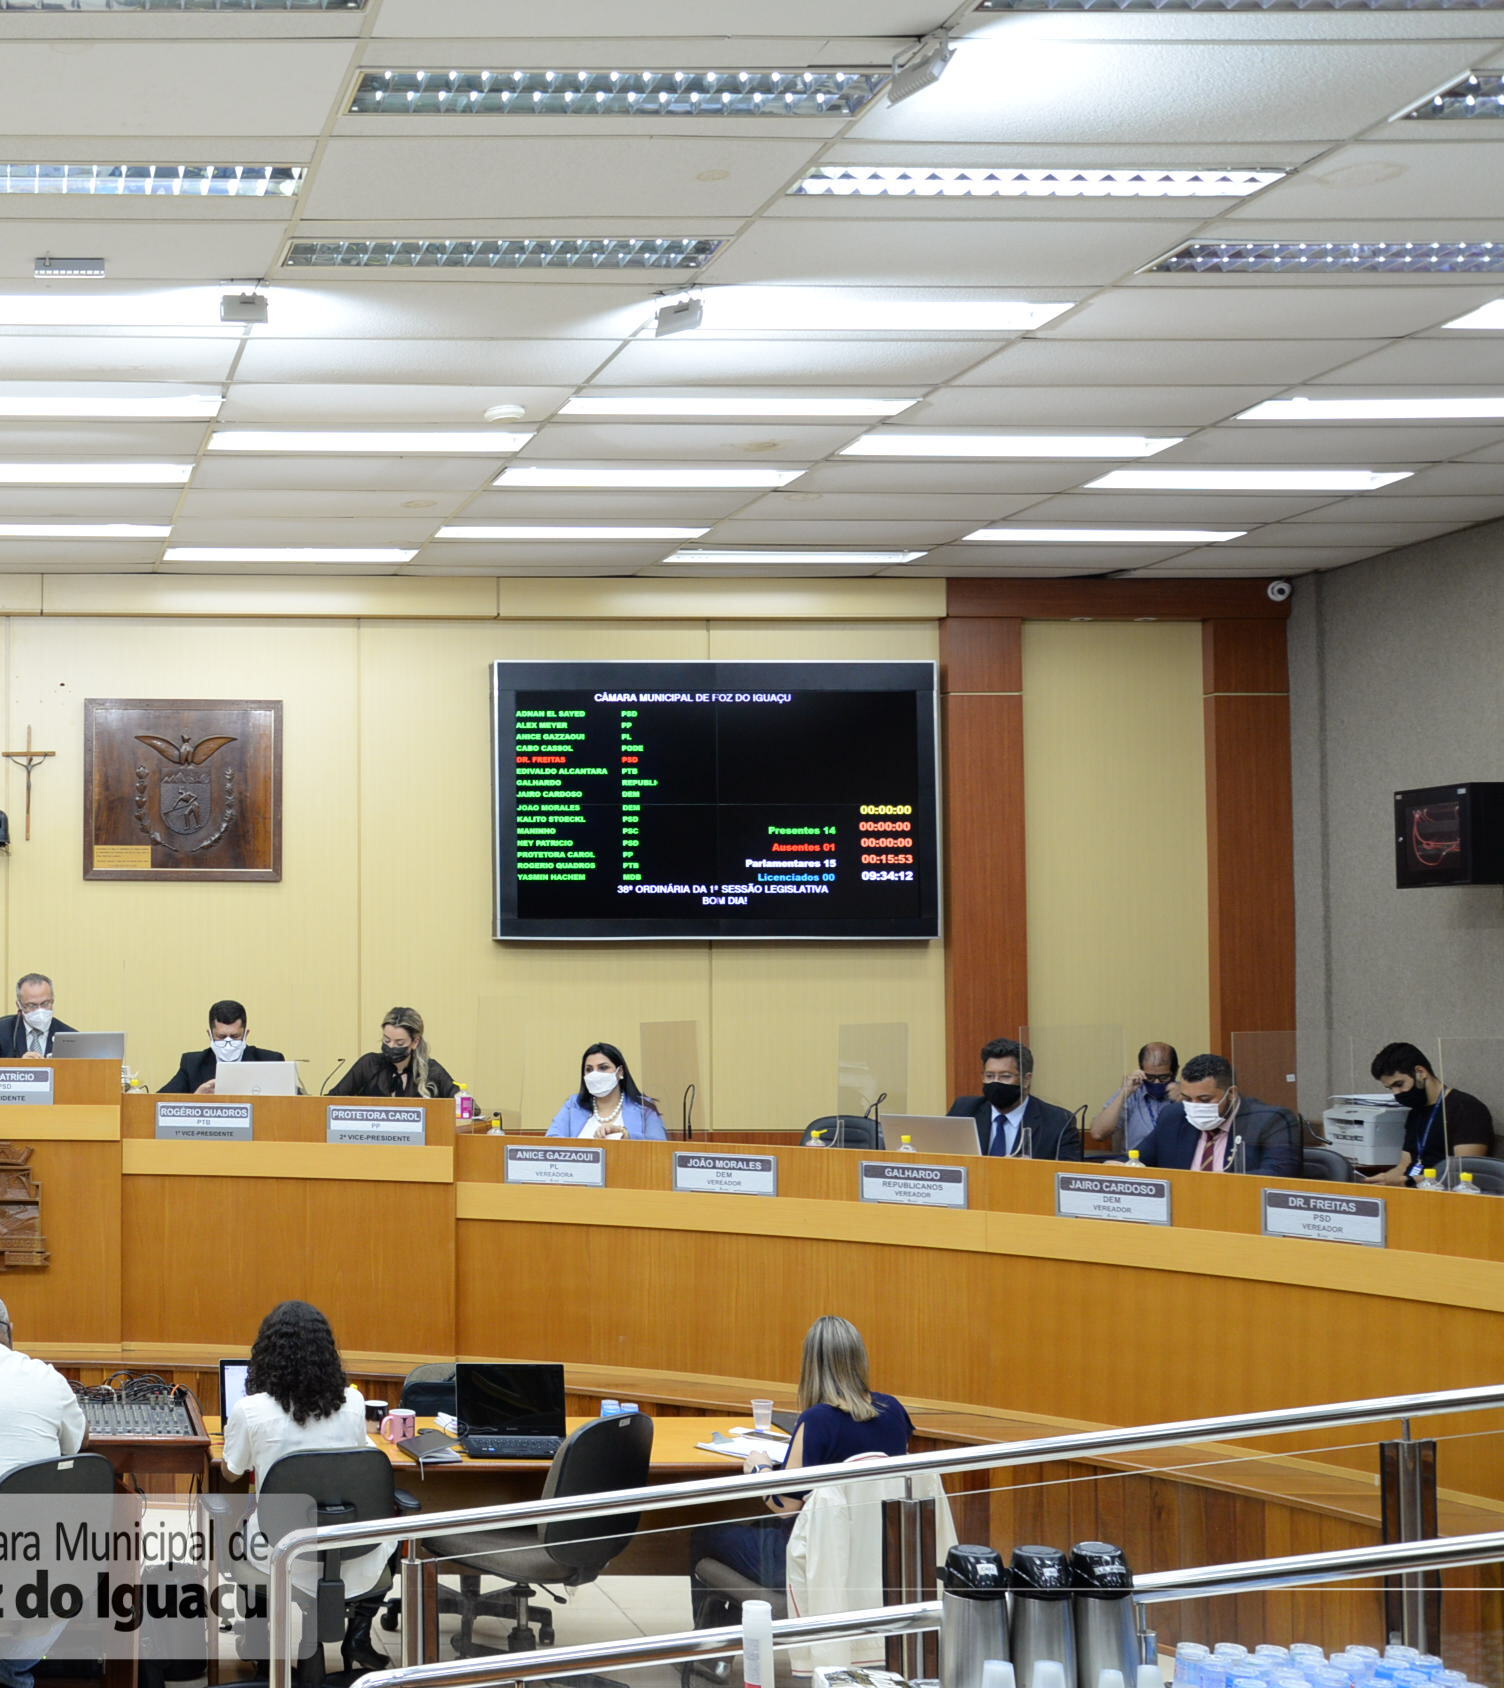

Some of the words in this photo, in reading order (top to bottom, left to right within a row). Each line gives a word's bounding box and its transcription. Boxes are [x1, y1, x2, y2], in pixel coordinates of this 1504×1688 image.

[594, 691, 637, 702] CÂMARA
[639, 694, 693, 702] MUNICIPAL
[695, 694, 709, 702] DE
[712, 694, 733, 702] FOZ
[735, 694, 750, 702] DO
[752, 694, 791, 704] IGUAÇU
[546, 710, 557, 718] EL
[558, 710, 586, 718] SAYED
[621, 710, 638, 718] PSD
[859, 805, 912, 815] 00:00:00
[768, 826, 821, 835] Presentes
[822, 826, 837, 835] 14
[859, 821, 911, 831] 00:00:00
[772, 843, 821, 852] Ausentes
[823, 843, 836, 852] 01
[860, 837, 913, 848] 00:00:00
[745, 859, 821, 868] Parlamentares
[823, 859, 837, 868] 15
[861, 854, 913, 864] 00:15:53
[758, 873, 820, 882] Licenciados
[822, 873, 835, 882] 00
[861, 871, 914, 881] 09:34:12
[635, 883, 691, 894] ORDINÁRIA
[692, 885, 707, 894] DA
[721, 883, 763, 894] SESSÃO
[764, 885, 829, 894] LEGISLATIVA
[702, 896, 726, 905] BOM
[727, 896, 748, 905] DIA!
[160, 1106, 201, 1117] ROGÉRIO
[203, 1108, 248, 1117] QUADROS
[332, 1110, 387, 1120] PROTETORA
[388, 1112, 420, 1121] CAROL
[347, 1134, 411, 1142] VICE-PRESIDENTE
[516, 1150, 545, 1160] ANICE
[546, 1151, 593, 1161] GAZZAOUI
[687, 1158, 714, 1168] JOÃO
[715, 1160, 762, 1170] MORALES
[885, 1168, 941, 1180] GALHARDO
[882, 1180, 944, 1191] REPUBLICANOS
[1069, 1180, 1101, 1191] JAIRO
[1102, 1182, 1156, 1195] CARDOSO
[894, 1190, 931, 1198] VEREADOR
[1103, 1195, 1121, 1204] DEM
[1093, 1204, 1132, 1213] VEREADOR
[1288, 1197, 1308, 1208] DR.
[1309, 1199, 1356, 1213] FREITAS
[1313, 1213, 1332, 1223] PSD
[1302, 1223, 1344, 1233] VEREADOR
